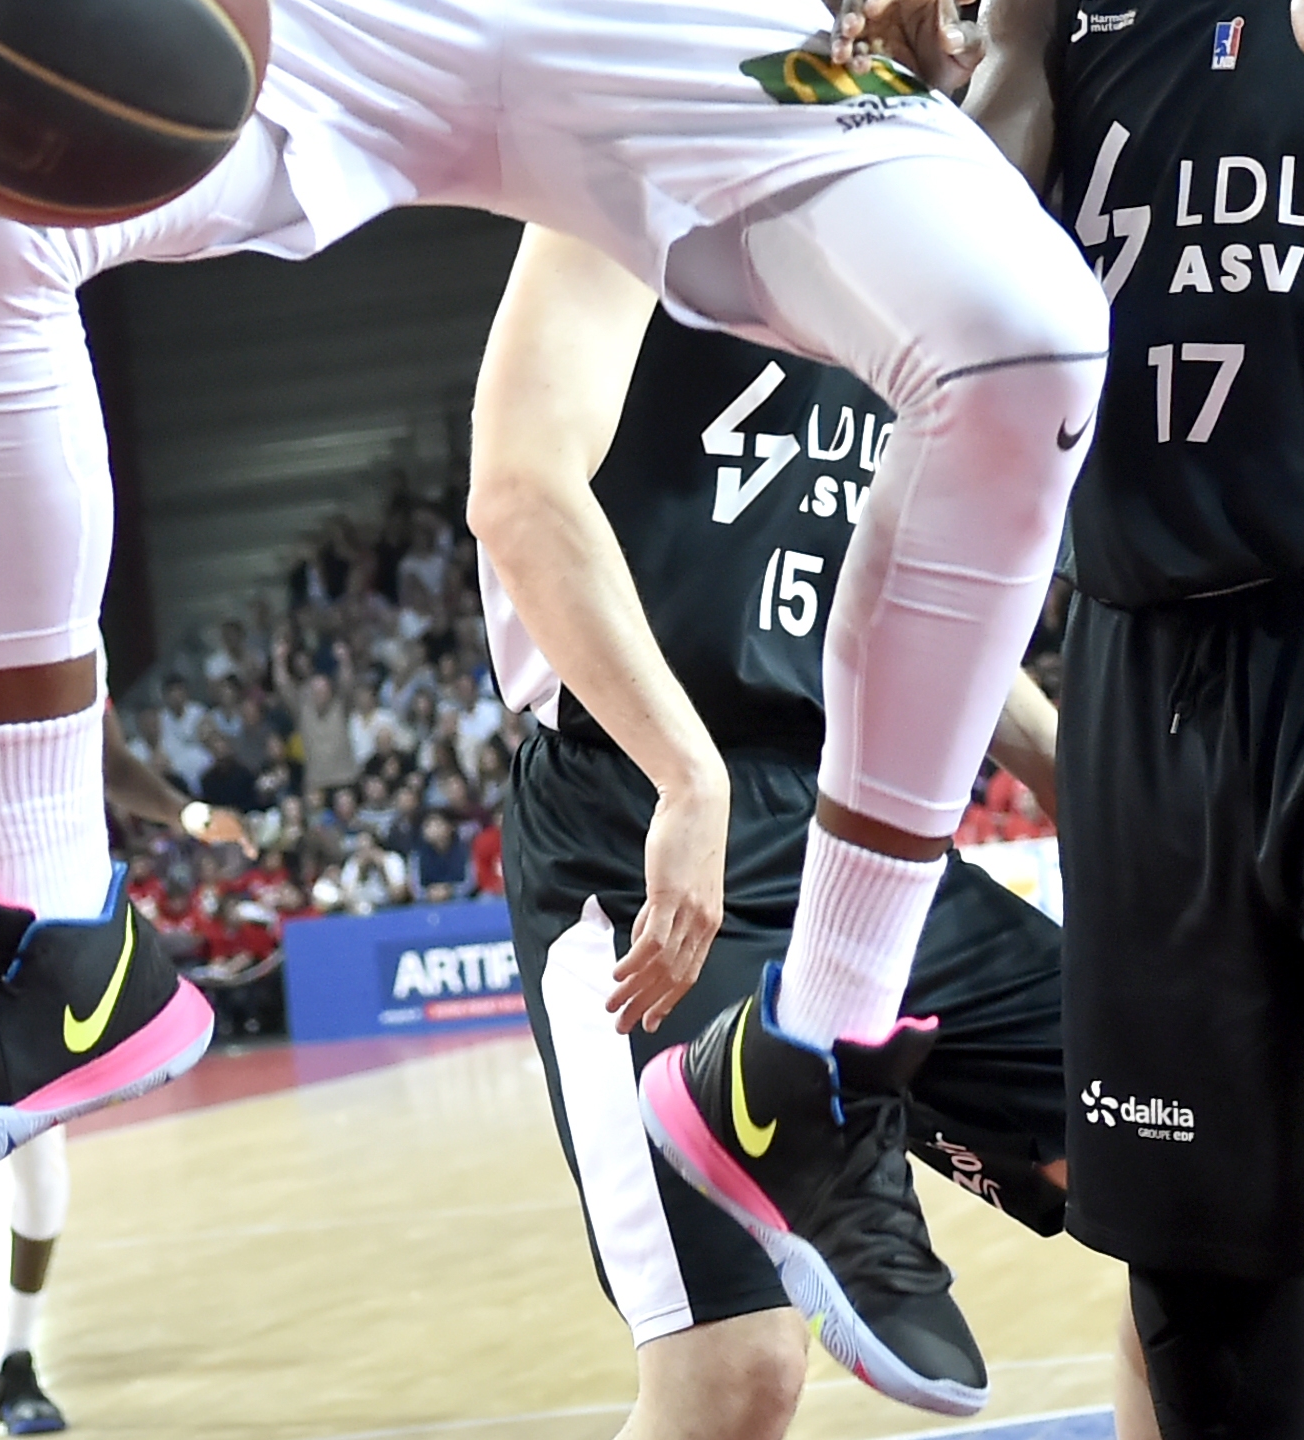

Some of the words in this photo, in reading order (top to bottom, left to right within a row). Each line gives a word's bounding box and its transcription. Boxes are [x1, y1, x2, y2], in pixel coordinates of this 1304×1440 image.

[1148, 343, 1245, 443] 17
[759, 548, 824, 637] 15
[1120, 1096, 1195, 1128] dalkia
[1138, 1127, 1172, 1140] GROUPE
